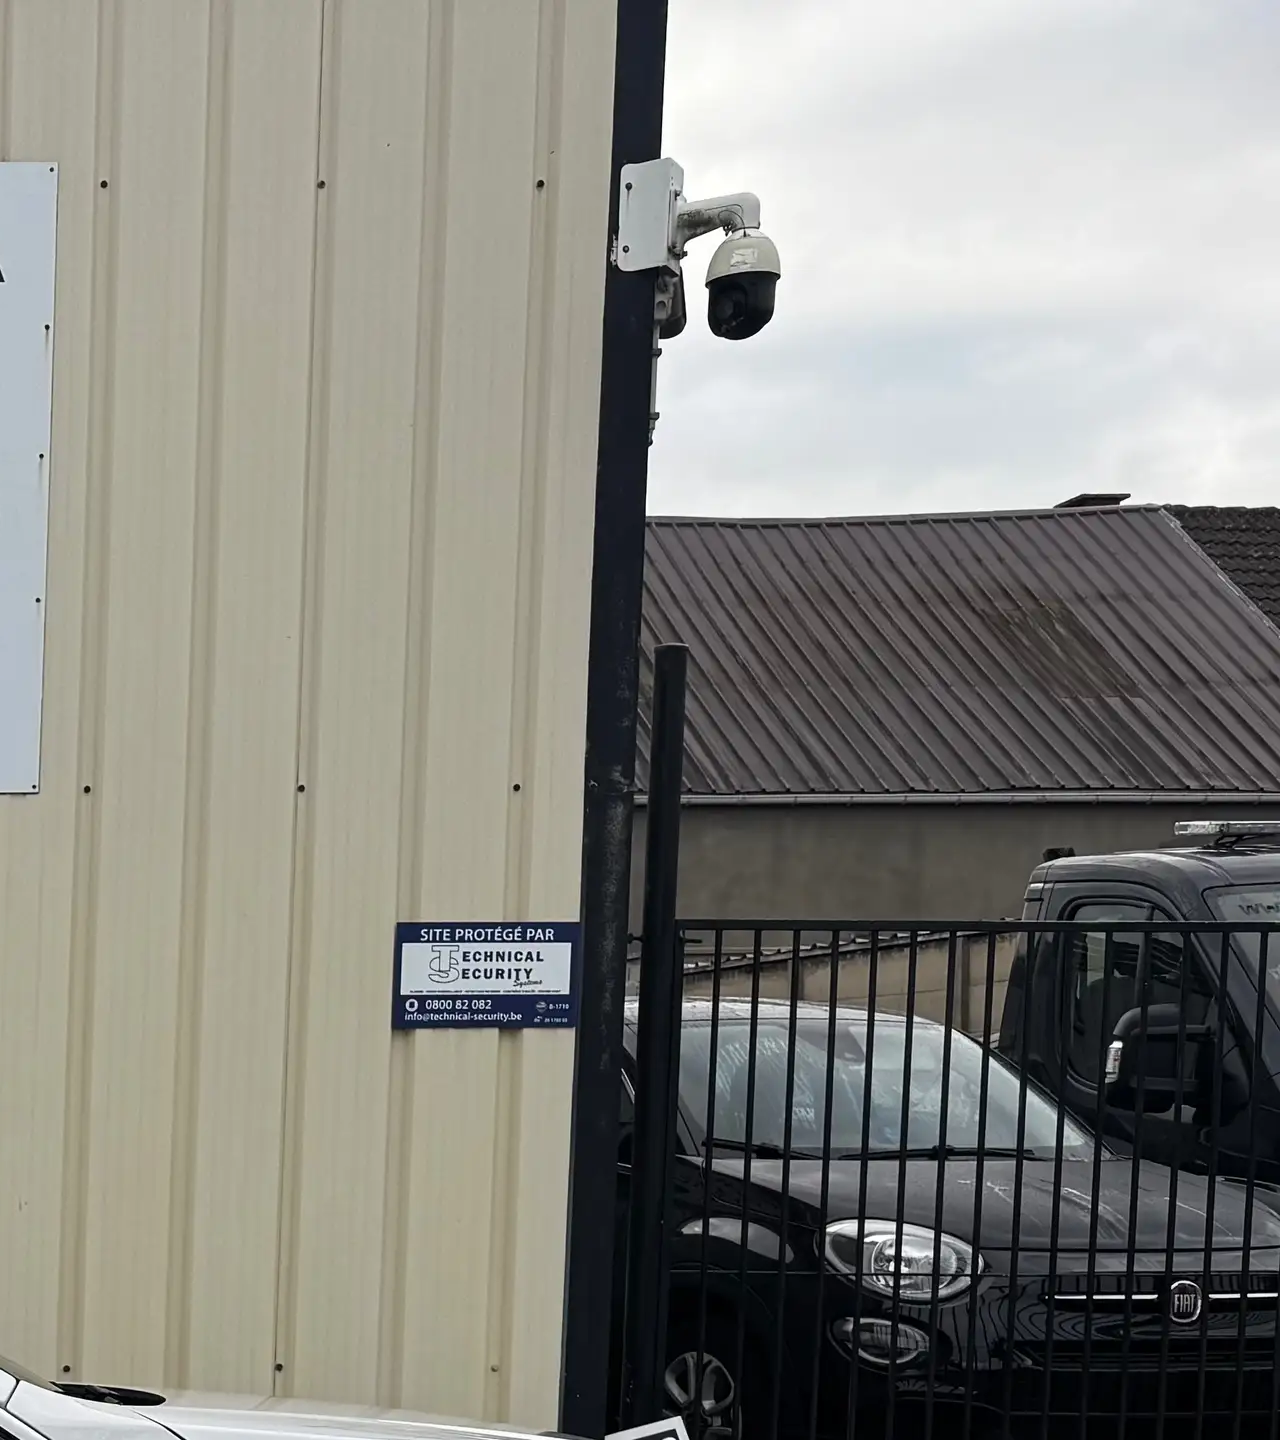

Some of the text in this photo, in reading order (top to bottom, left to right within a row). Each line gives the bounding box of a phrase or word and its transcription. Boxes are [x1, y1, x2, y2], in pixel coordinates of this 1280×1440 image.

[420, 926, 555, 942] SITE PROTÉGÉ PAR
[425, 999, 453, 1011] 0800
[455, 999, 469, 1011] 82
[471, 999, 492, 1011] 082
[404, 1012, 523, 1023] info@technical-security.be
[1173, 1293, 1196, 1312] FIAT
